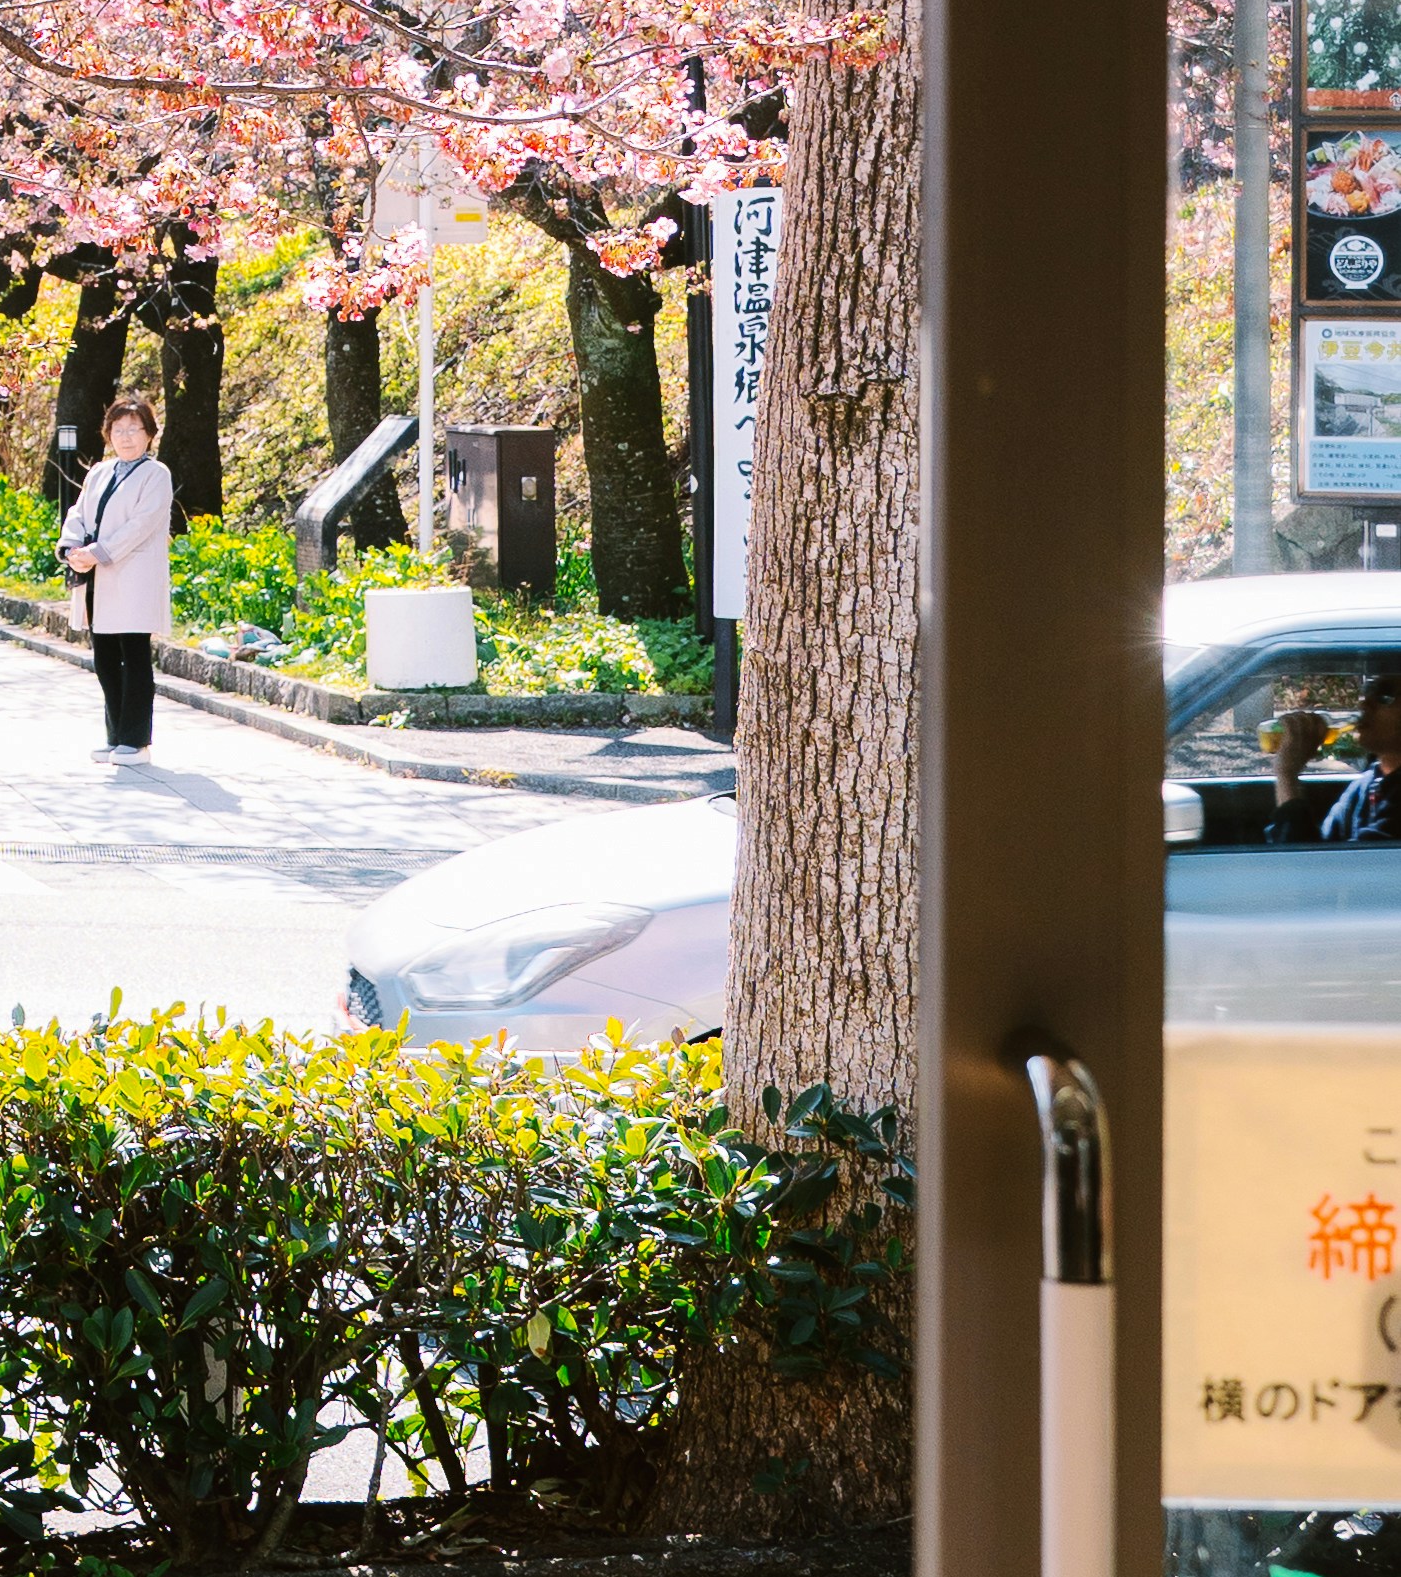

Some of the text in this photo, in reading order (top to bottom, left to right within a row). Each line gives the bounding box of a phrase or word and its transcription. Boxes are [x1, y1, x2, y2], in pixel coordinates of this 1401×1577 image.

[1308, 1192, 1398, 1282] 締
[1202, 1375, 1401, 1424] 横のドア
